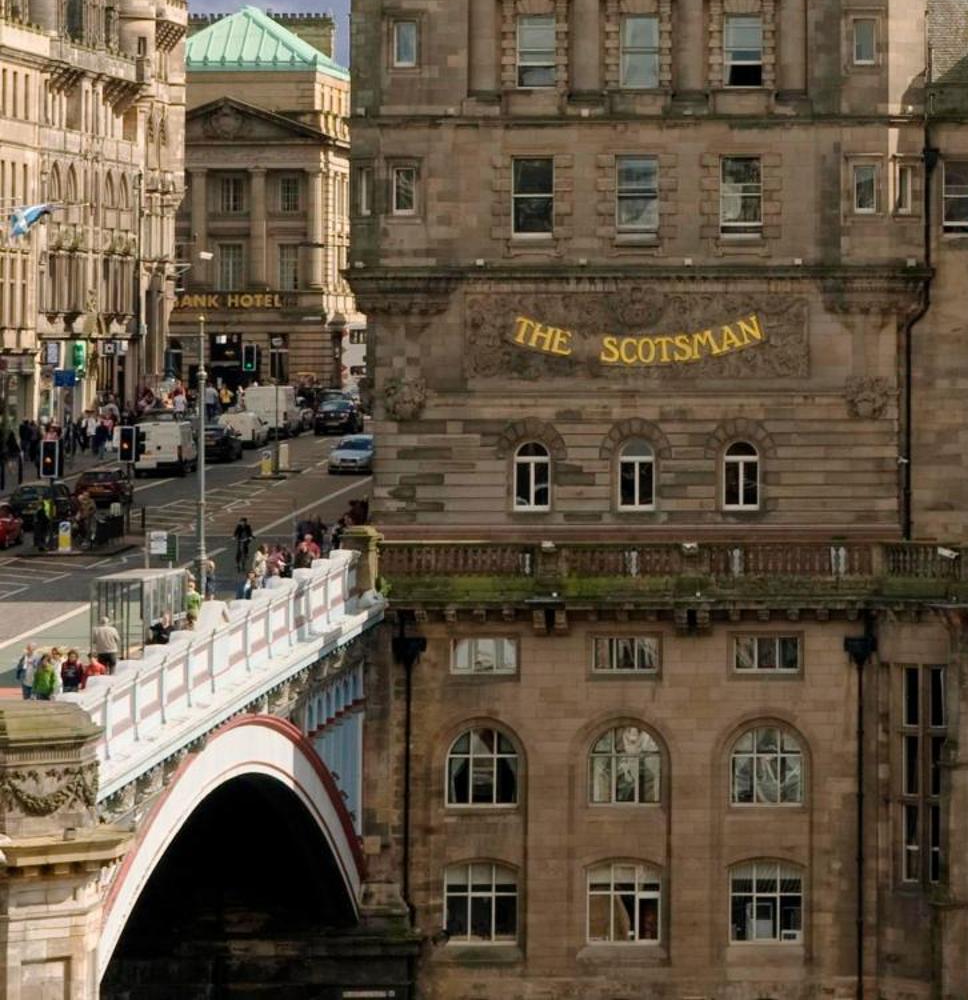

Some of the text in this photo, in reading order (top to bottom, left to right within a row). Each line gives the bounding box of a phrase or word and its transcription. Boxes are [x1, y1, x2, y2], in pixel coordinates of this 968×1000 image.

[175, 294, 283, 308] ANK HOTEL
[514, 314, 764, 363] THE SCOTSMAN
